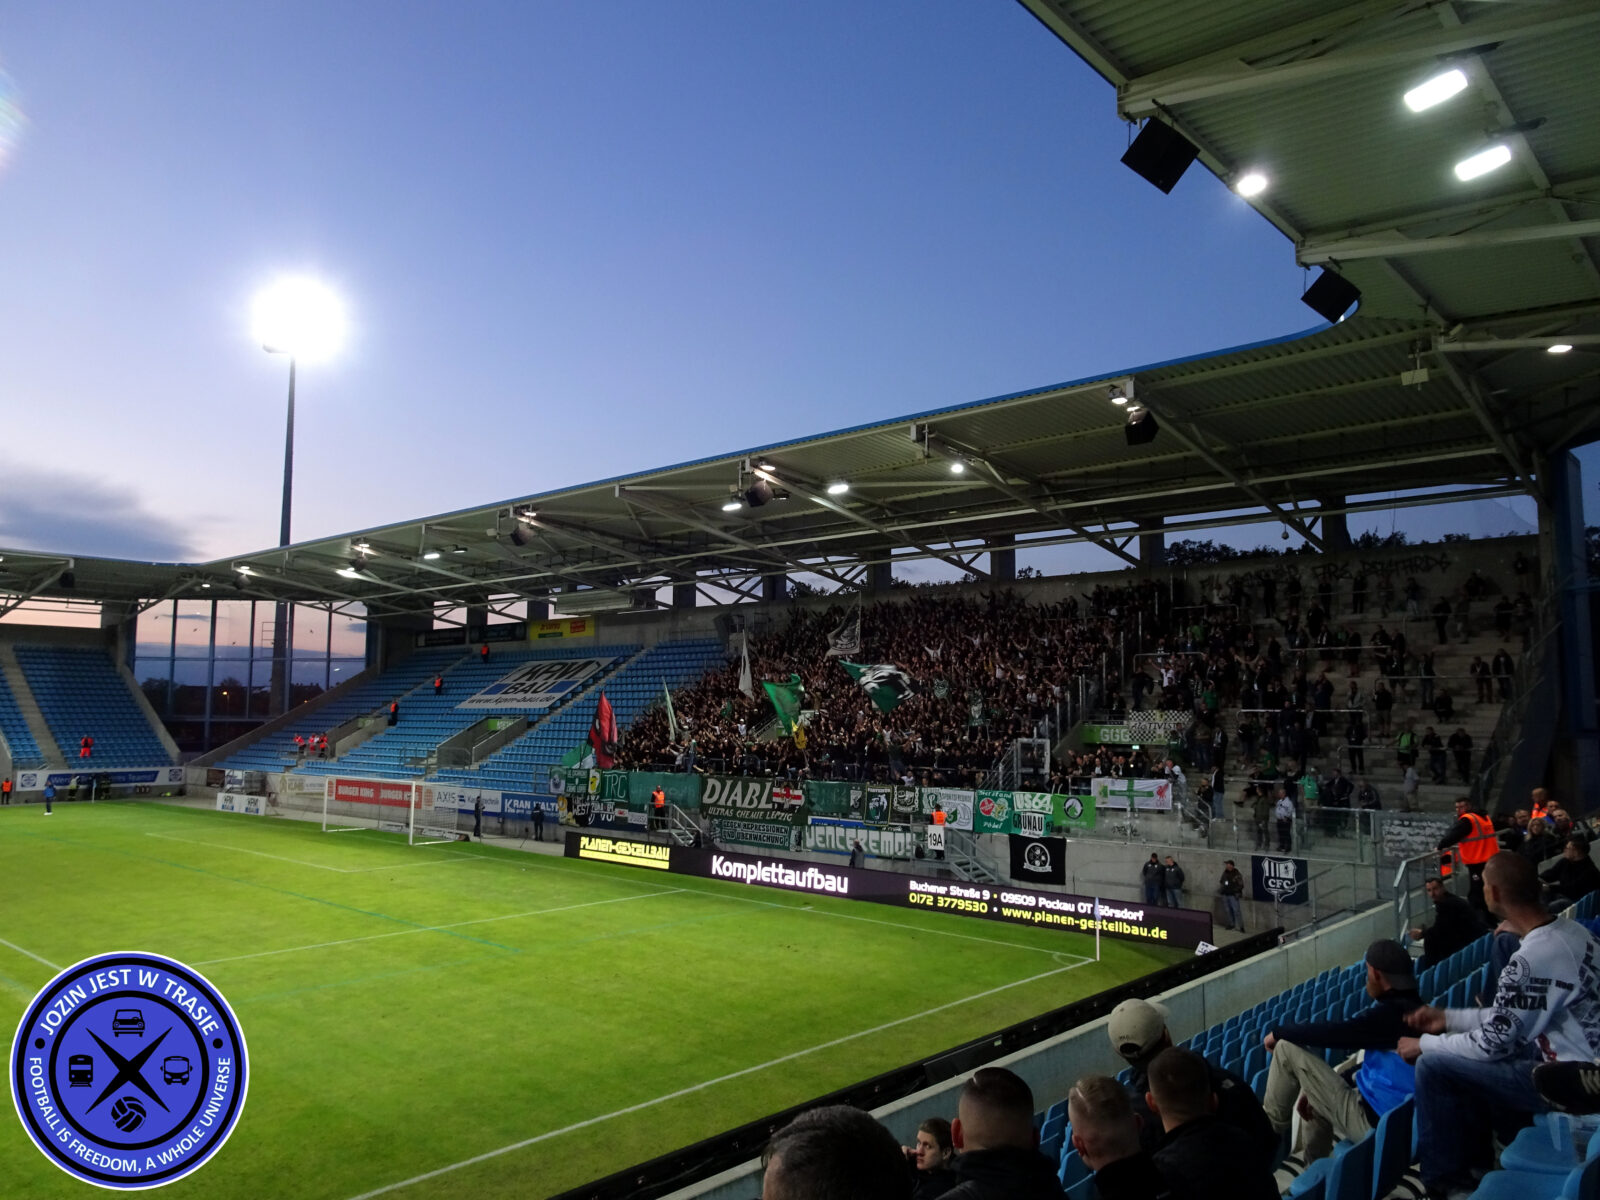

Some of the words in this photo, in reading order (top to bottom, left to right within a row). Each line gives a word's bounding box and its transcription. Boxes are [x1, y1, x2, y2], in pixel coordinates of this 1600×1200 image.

[500, 682, 556, 695] BAU
[338, 785, 359, 796] BURGER
[360, 787, 375, 798] KING
[604, 774, 627, 799] TRC
[702, 778, 805, 809] DIABL
[505, 799, 531, 813] KRAN
[533, 800, 558, 812] WALT
[708, 806, 734, 817] ULTRAS
[736, 810, 764, 819] CHEMIE
[766, 811, 793, 822] LEIPZIG
[928, 833, 943, 847] 19A
[711, 854, 849, 894] Komplettaufbau
[1268, 878, 1291, 889] CFC
[949, 885, 981, 899] Straße
[981, 889, 991, 900] 9
[1038, 896, 1075, 912] Pockau
[1077, 901, 1094, 914] OT
[909, 892, 934, 906] 0172
[937, 896, 989, 914] 3779530
[1001, 907, 1168, 940] www.planen-gestellbau.de
